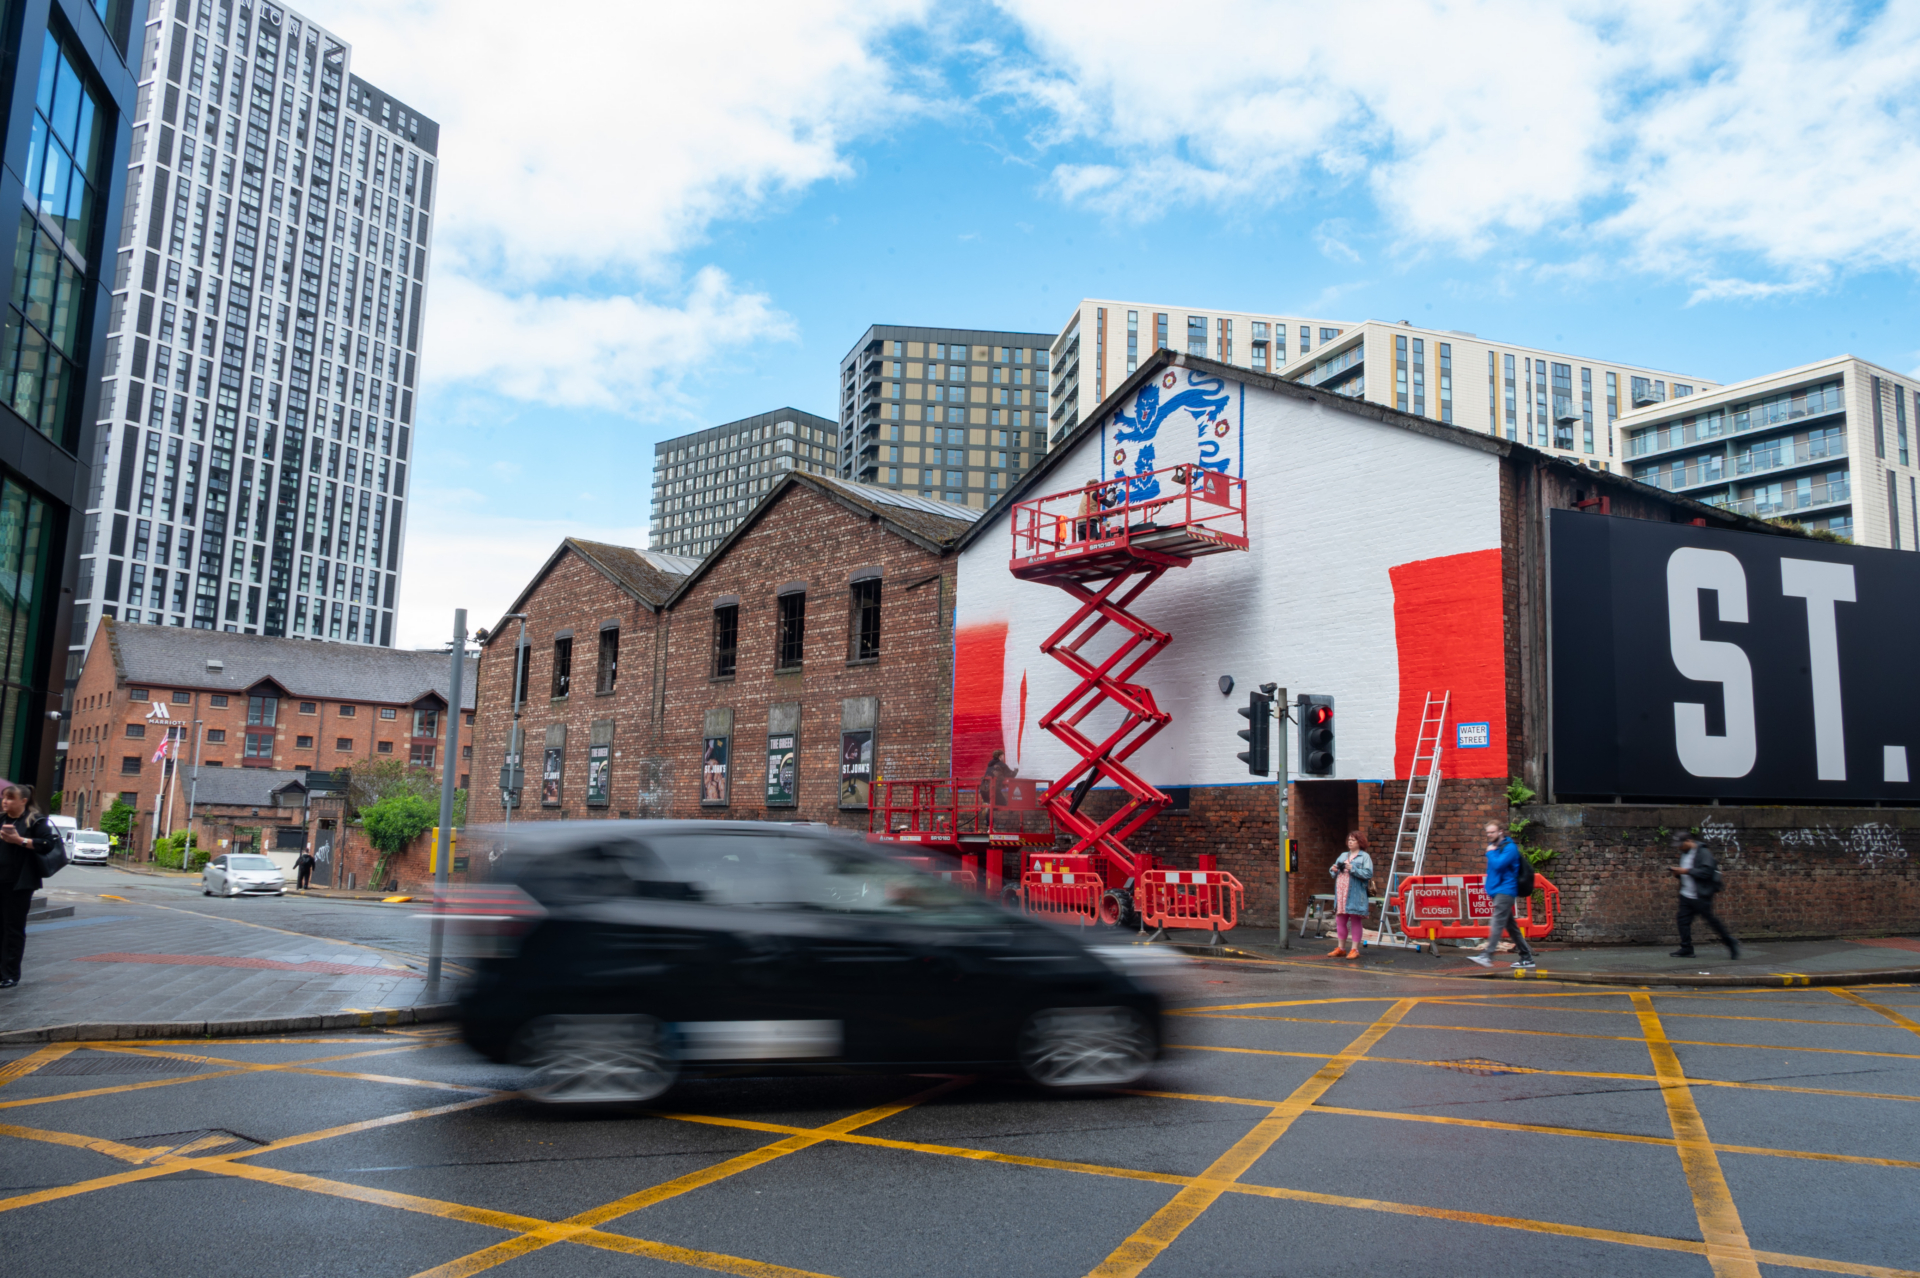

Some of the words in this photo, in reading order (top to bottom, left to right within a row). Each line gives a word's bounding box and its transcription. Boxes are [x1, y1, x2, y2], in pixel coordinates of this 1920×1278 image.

[240, 0, 299, 38] NION
[1666, 546, 1910, 783] ST.
[1460, 725, 1486, 734] WATER
[770, 738, 779, 750] THE
[779, 737, 793, 749] GREEN
[1459, 735, 1487, 744] STREET
[1415, 889, 1457, 897] FOOTPATH
[1421, 907, 1453, 915] CLOSED
